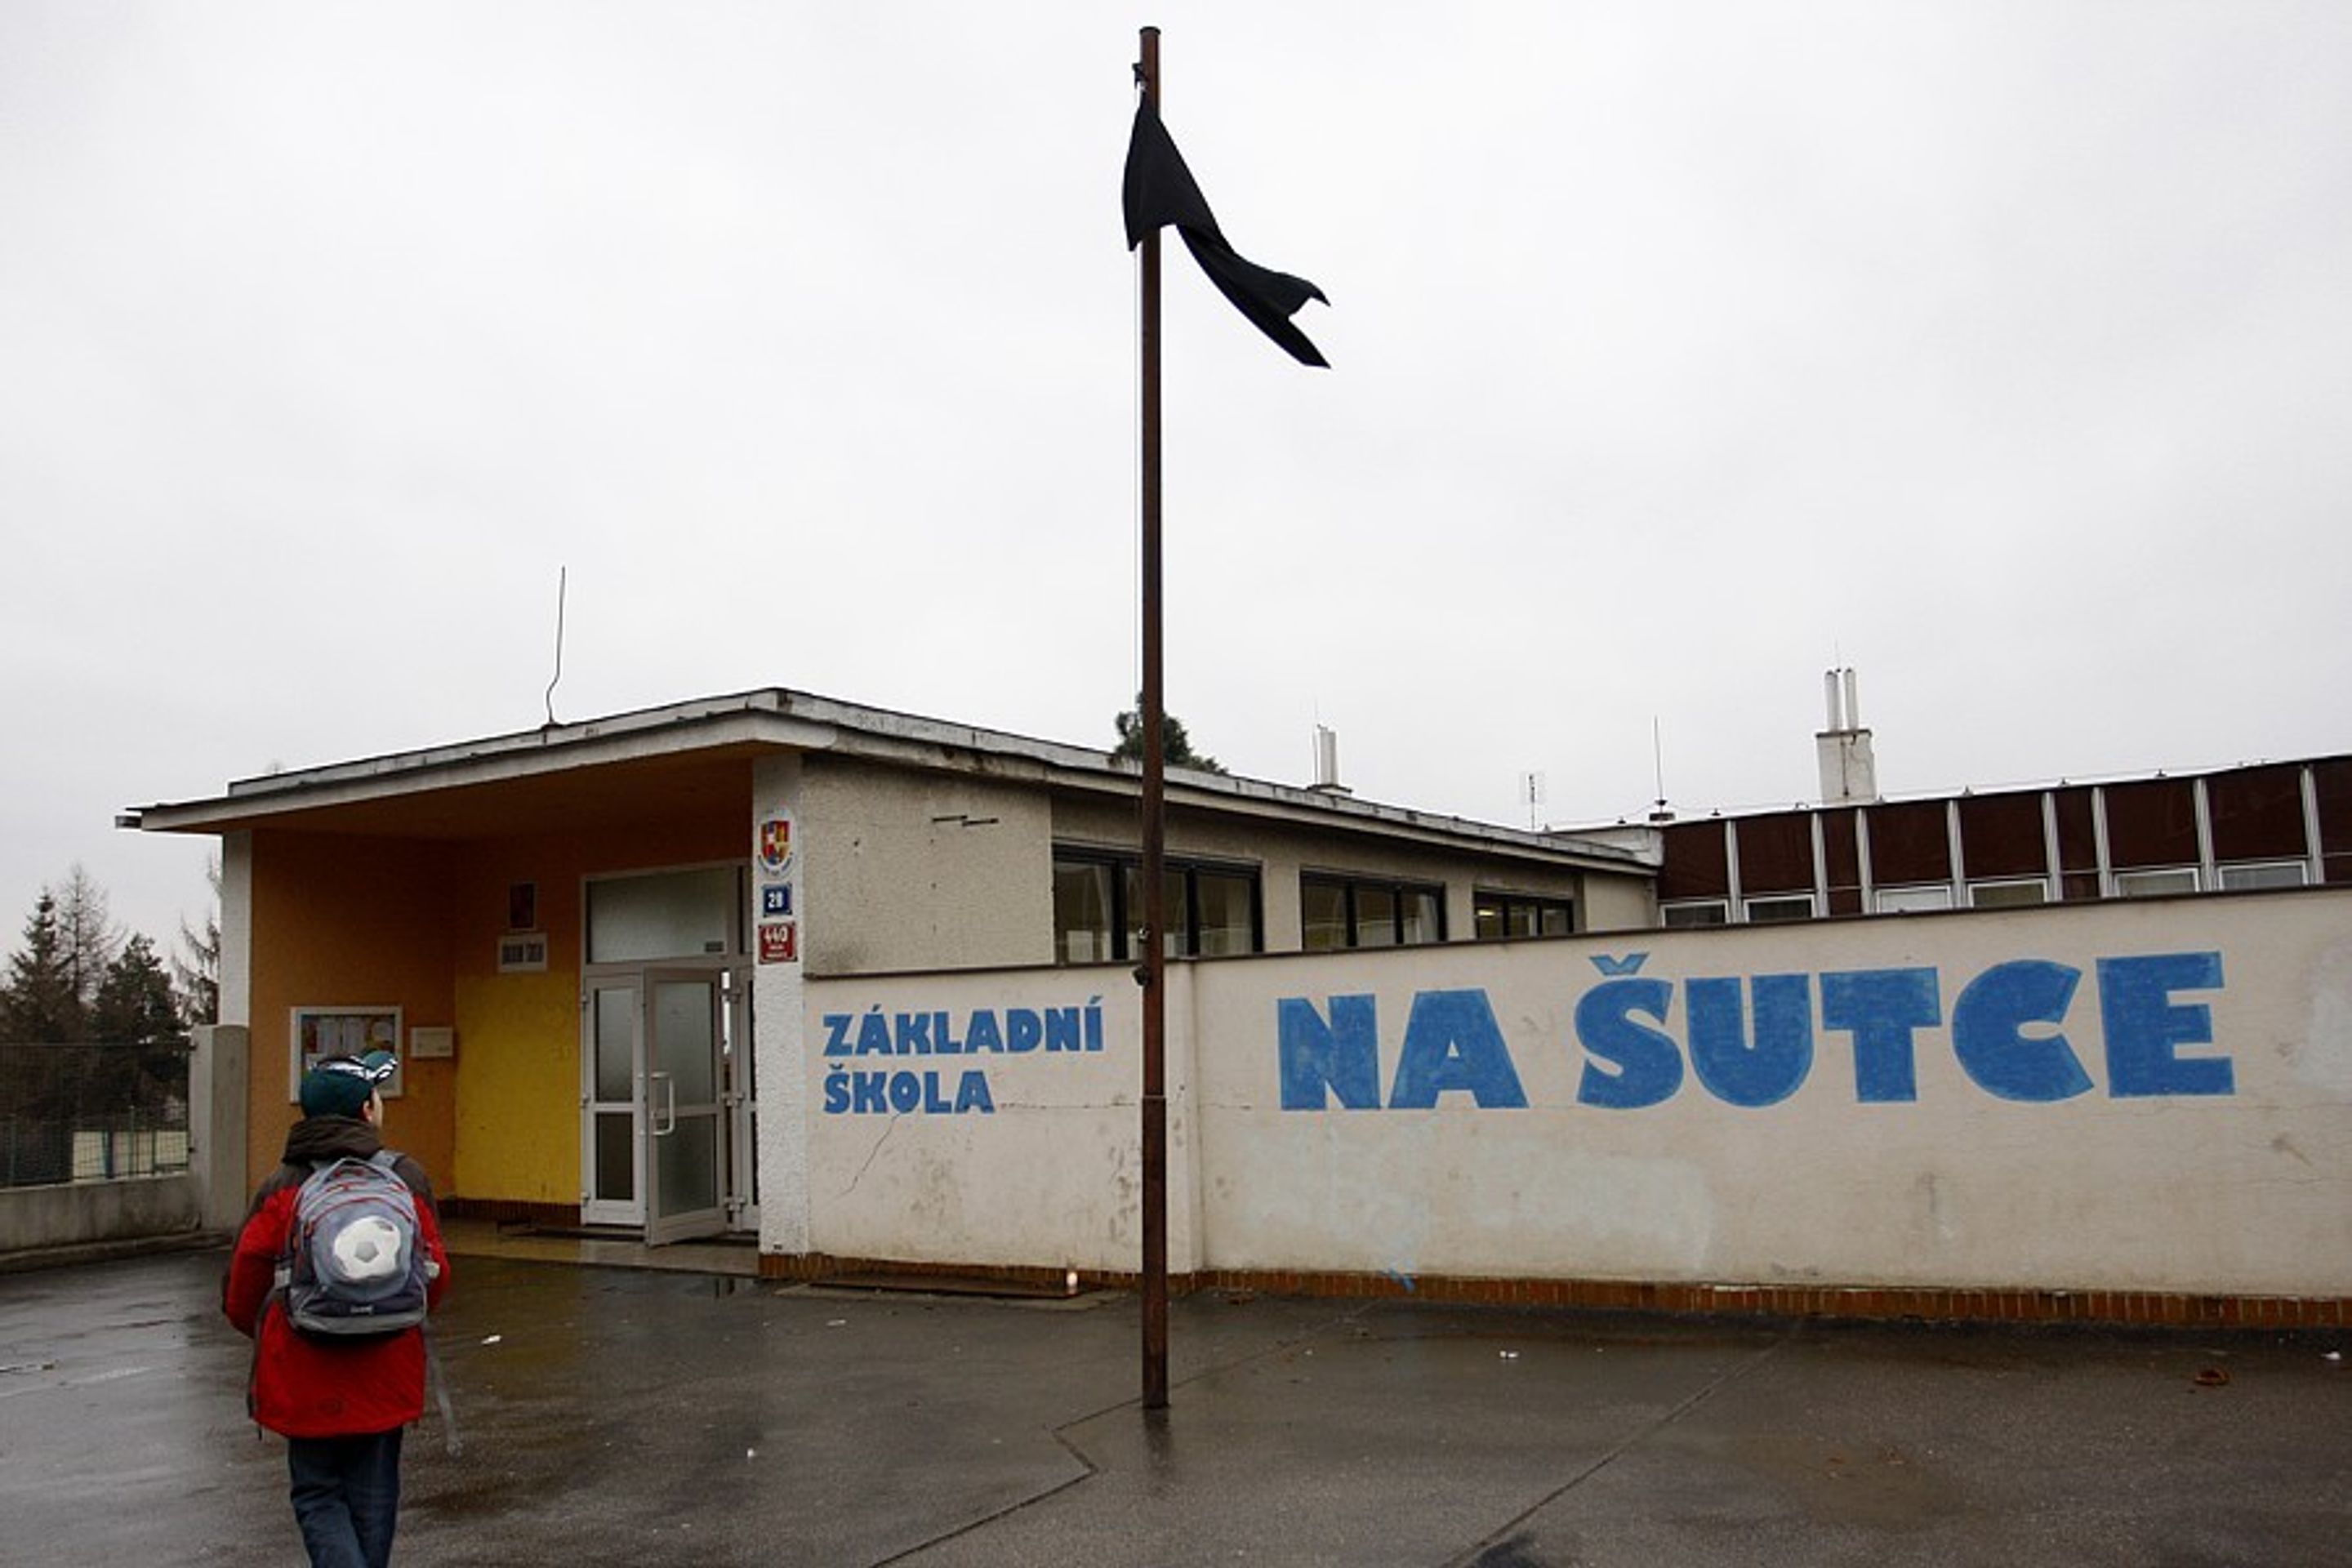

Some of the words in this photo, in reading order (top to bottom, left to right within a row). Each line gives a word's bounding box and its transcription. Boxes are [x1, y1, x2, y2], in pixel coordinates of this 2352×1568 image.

[822, 996, 1103, 1057] ZÁKLADNÍ
[1277, 988, 1529, 1111] NA
[1575, 951, 2235, 1108] ŠUTCE
[823, 1064, 996, 1114] ŠKOLA
